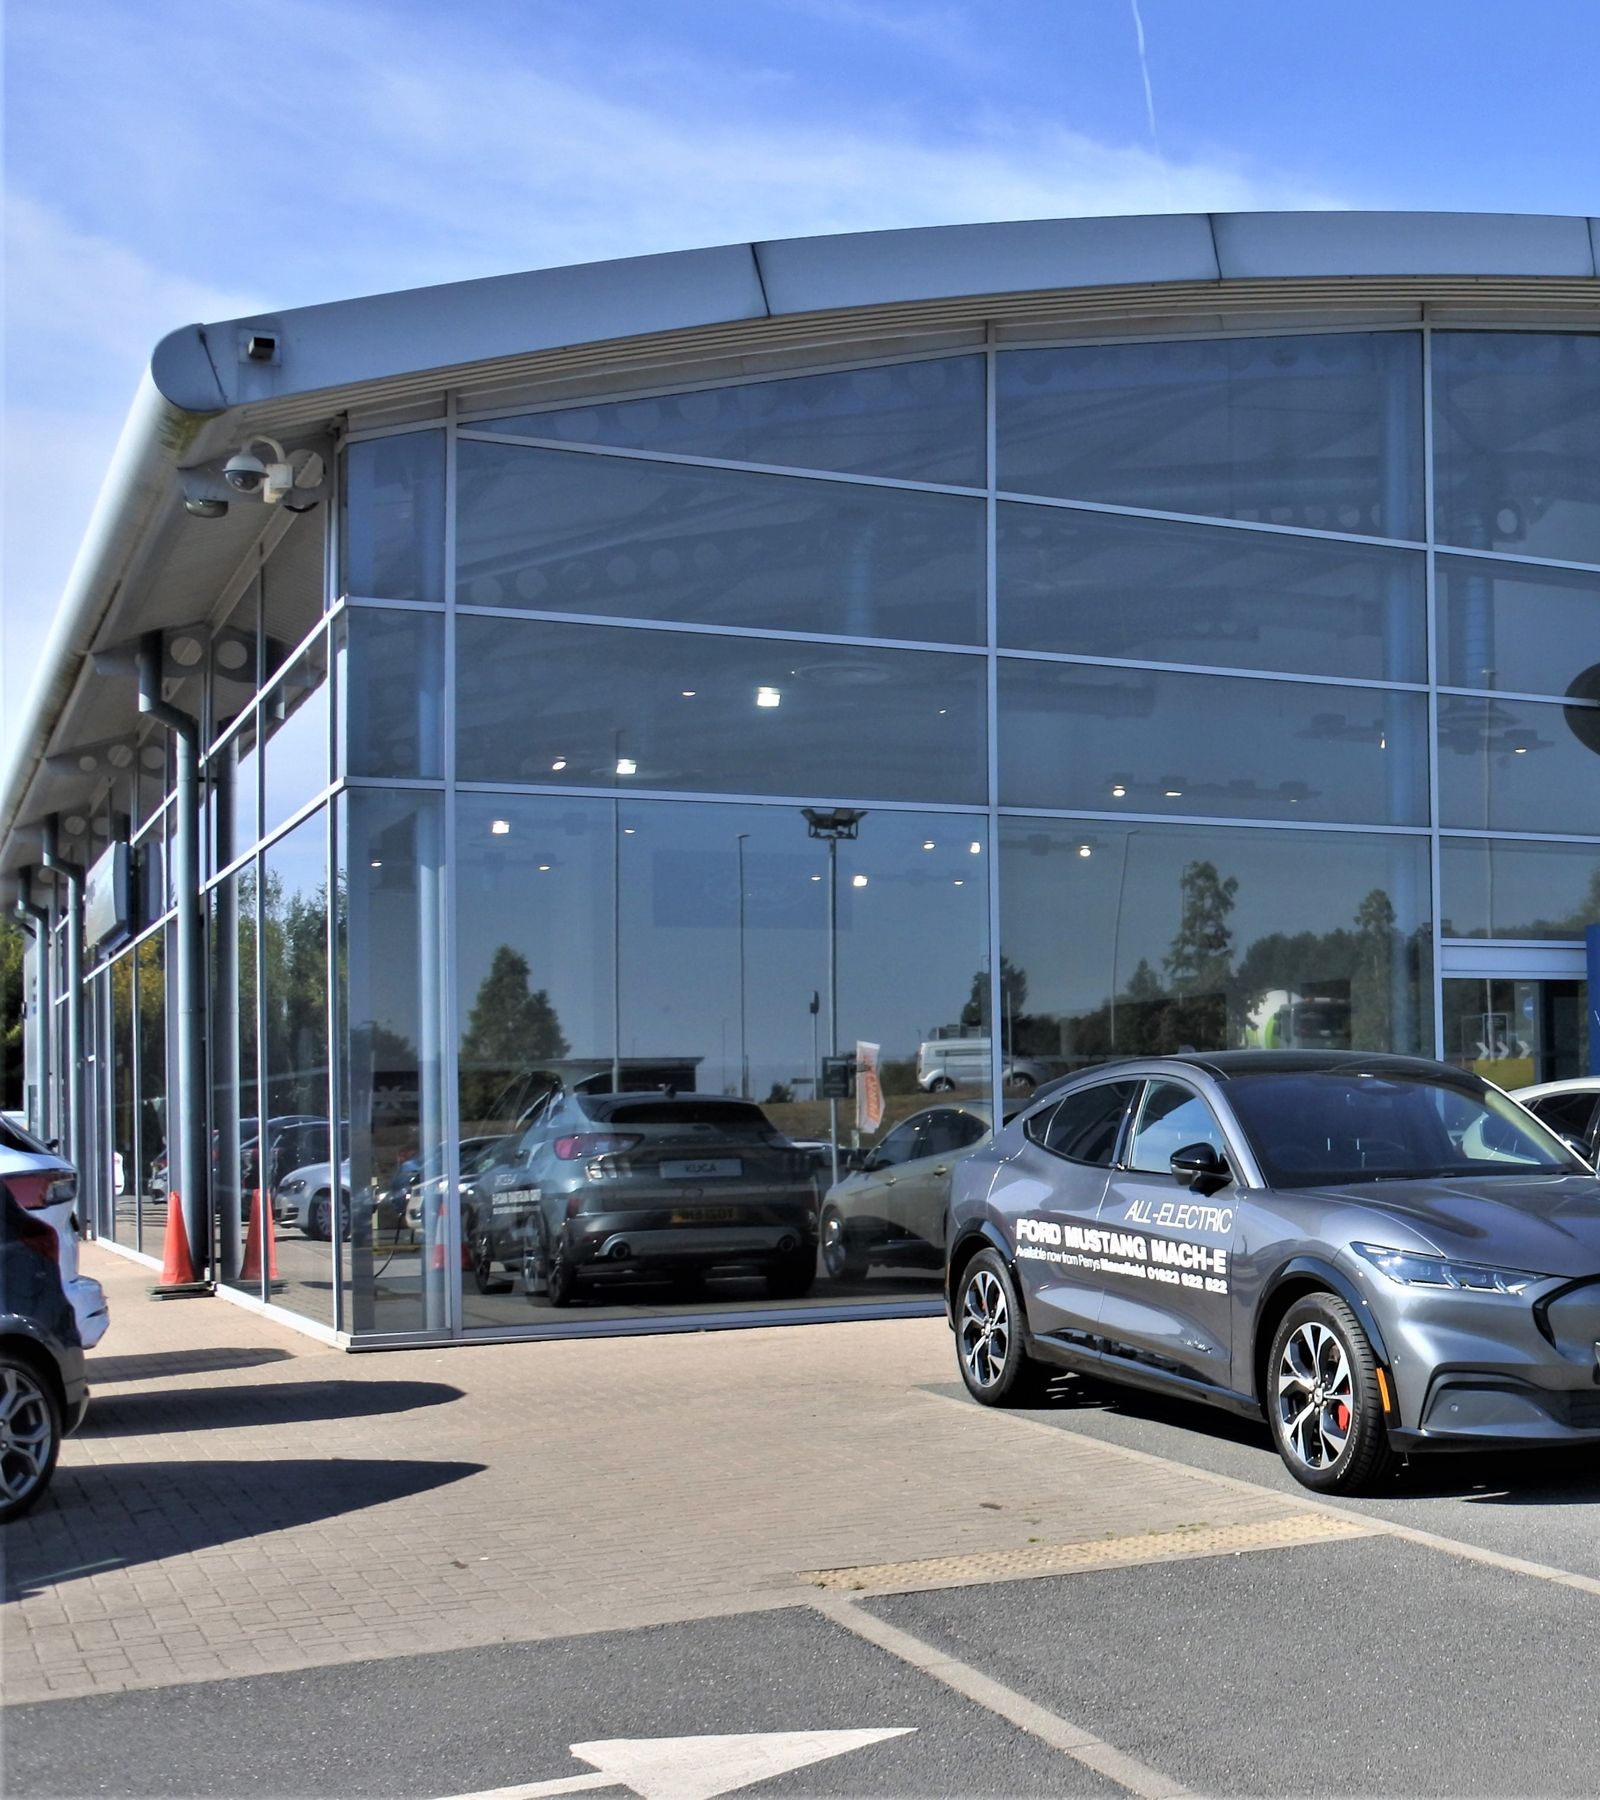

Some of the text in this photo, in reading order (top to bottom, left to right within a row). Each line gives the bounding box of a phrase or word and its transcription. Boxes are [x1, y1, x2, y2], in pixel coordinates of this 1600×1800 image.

[1124, 1199, 1233, 1234] ALL-ELECTRIC
[1015, 1218, 1227, 1275] FORD MUSTANG MACH-E
[1015, 1244, 1047, 1260] Available
[1046, 1250, 1062, 1263] now
[1061, 1251, 1078, 1266] from
[1079, 1254, 1101, 1272] Perrys
